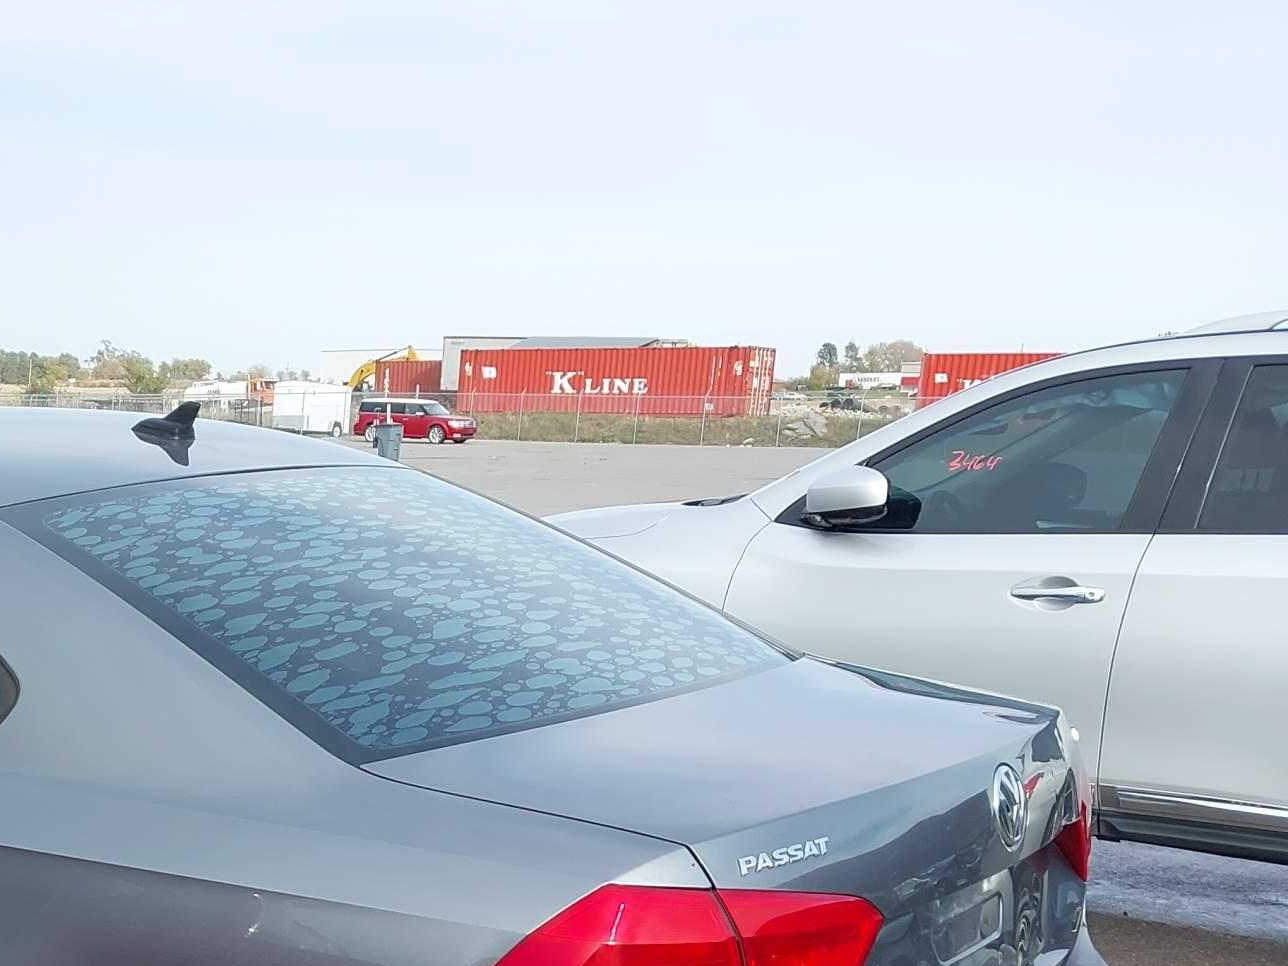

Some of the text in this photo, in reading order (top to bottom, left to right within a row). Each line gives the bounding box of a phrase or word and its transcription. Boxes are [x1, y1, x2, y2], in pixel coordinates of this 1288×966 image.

[584, 378, 649, 394] LINE
[949, 450, 1003, 472] 3464
[736, 837, 829, 876] PASSAT
